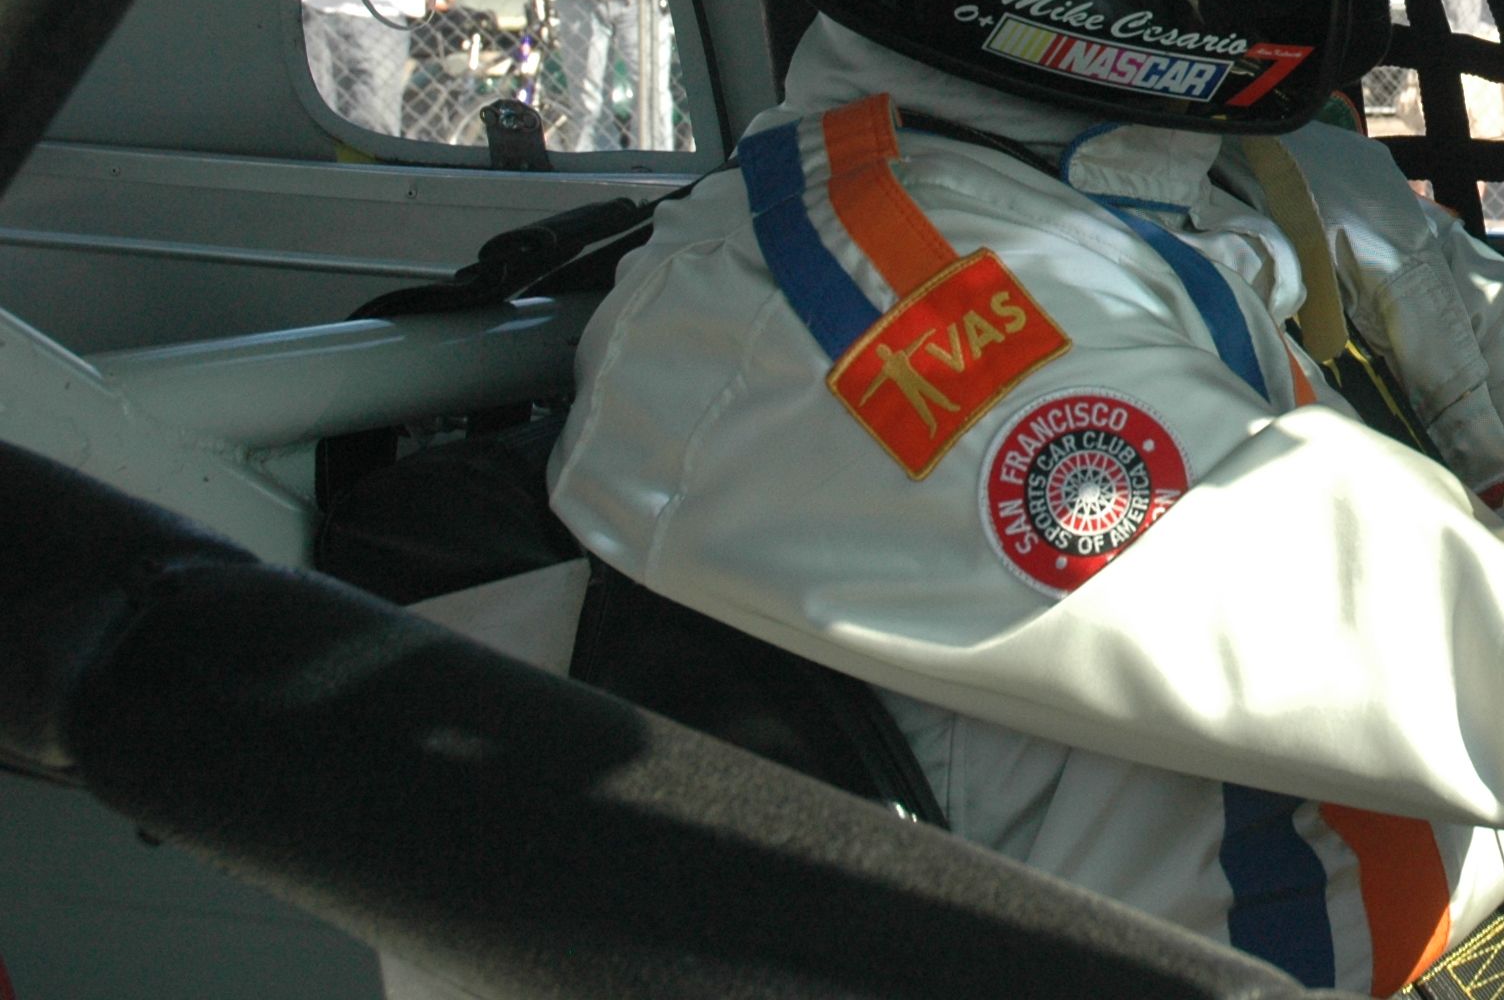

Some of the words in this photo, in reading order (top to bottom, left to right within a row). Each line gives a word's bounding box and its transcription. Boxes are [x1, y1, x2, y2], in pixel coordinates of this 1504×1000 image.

[1110, 10, 1248, 56] Cesario
[1059, 38, 1211, 96] NASCAR
[1226, 42, 1314, 107] 7
[1001, 403, 1128, 485] FRANCISCO
[1036, 434, 1076, 471] CAR
[1082, 430, 1136, 463] CLUB
[1000, 499, 1039, 554] SAN
[1028, 473, 1073, 549] SPORTS
[1077, 535, 1104, 555] OF
[1110, 462, 1150, 547] AMERICA
